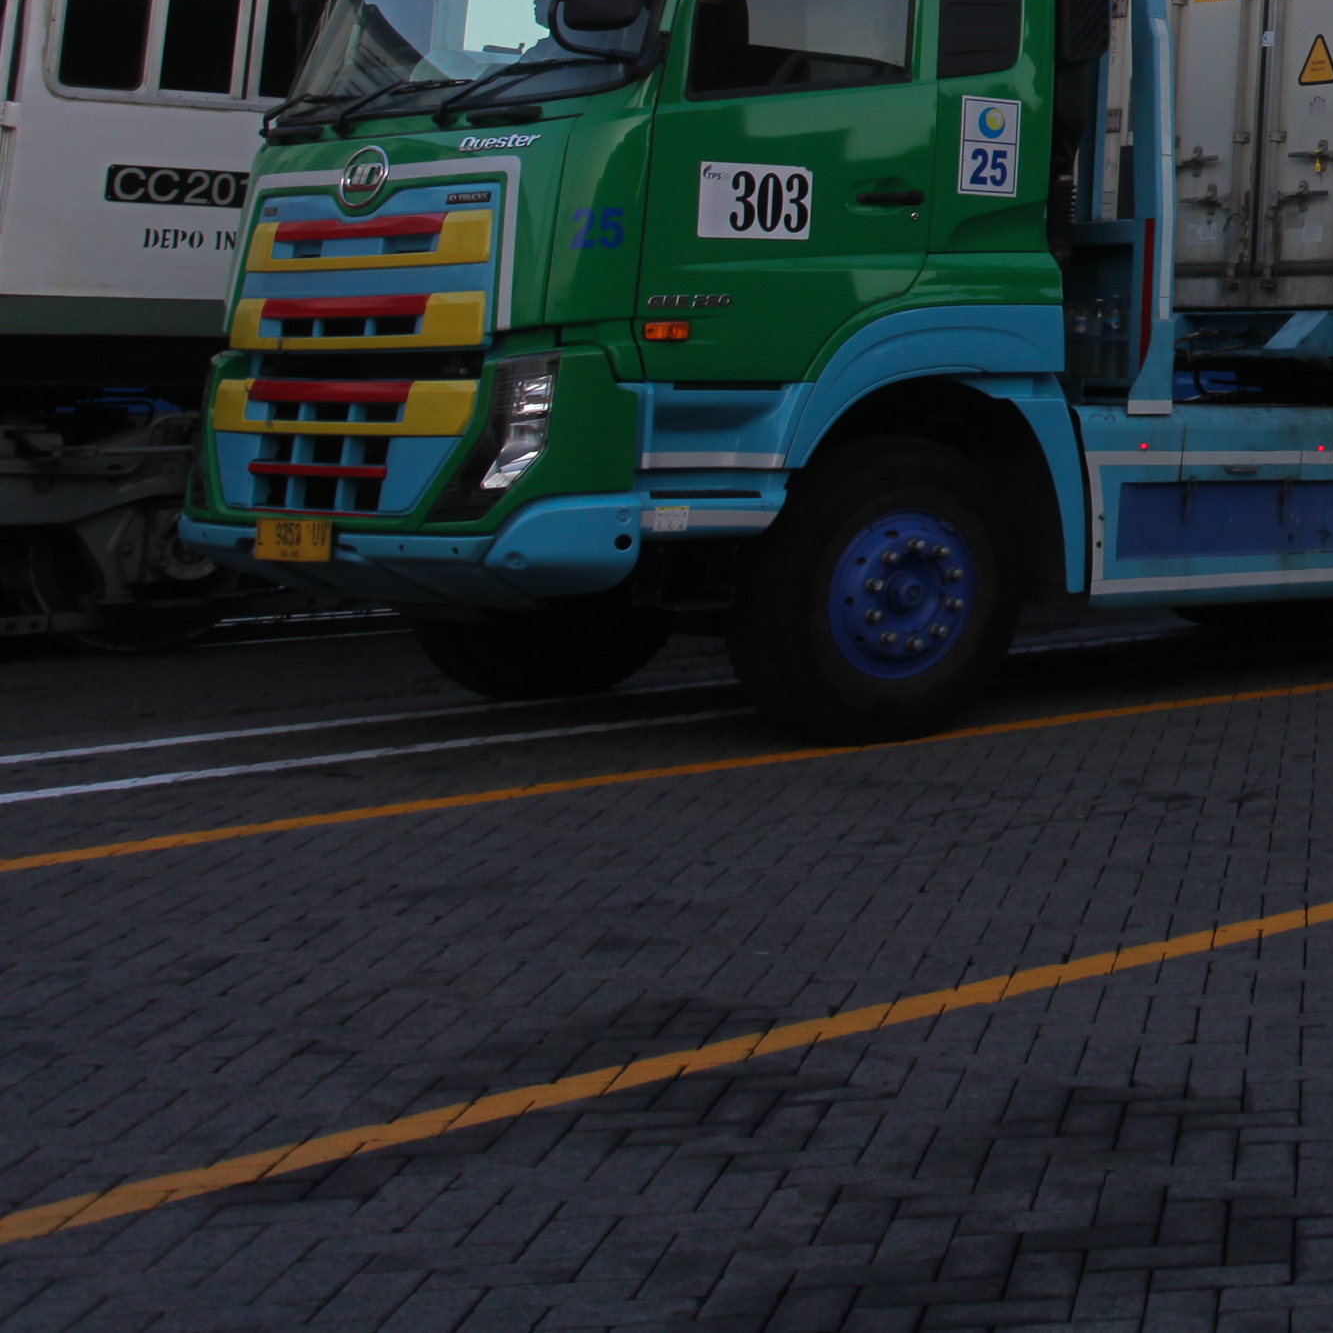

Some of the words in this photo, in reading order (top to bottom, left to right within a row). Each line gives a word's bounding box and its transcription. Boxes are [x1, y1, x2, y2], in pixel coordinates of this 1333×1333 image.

[459, 133, 542, 153] Quester
[113, 167, 249, 207] CC20
[707, 171, 722, 181] TPS
[969, 147, 1008, 187] 25
[729, 170, 809, 233] 303
[142, 227, 205, 249] DEPO
[570, 207, 625, 249] 25
